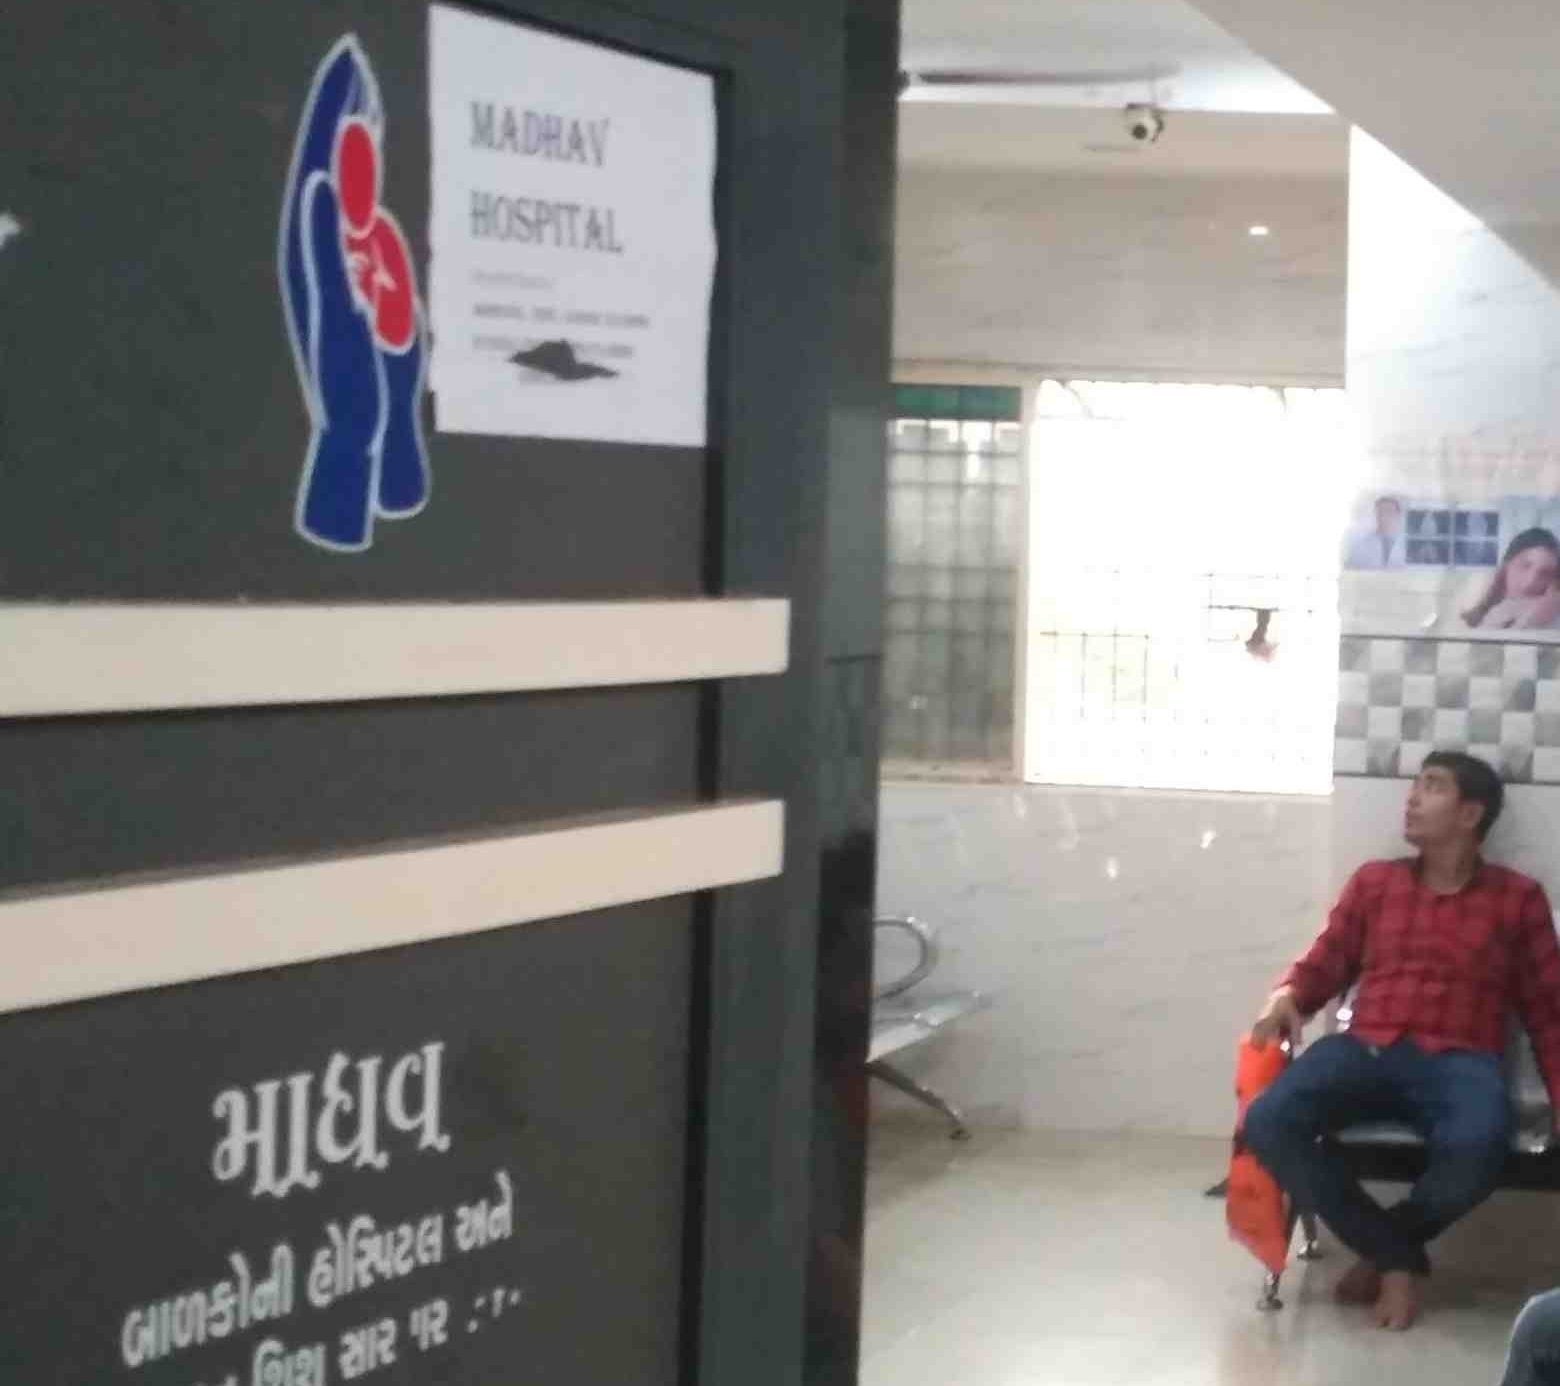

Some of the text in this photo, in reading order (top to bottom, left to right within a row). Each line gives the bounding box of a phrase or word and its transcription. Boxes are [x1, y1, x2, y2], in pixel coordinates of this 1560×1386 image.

[469, 101, 609, 168] MADHAV
[469, 191, 624, 254] HOSPITAL
[211, 1039, 452, 1200] માધવ
[120, 1240, 296, 1369] બાળકોની
[305, 1212, 445, 1310] હોસ્પિટલ
[452, 1168, 515, 1254] અને
